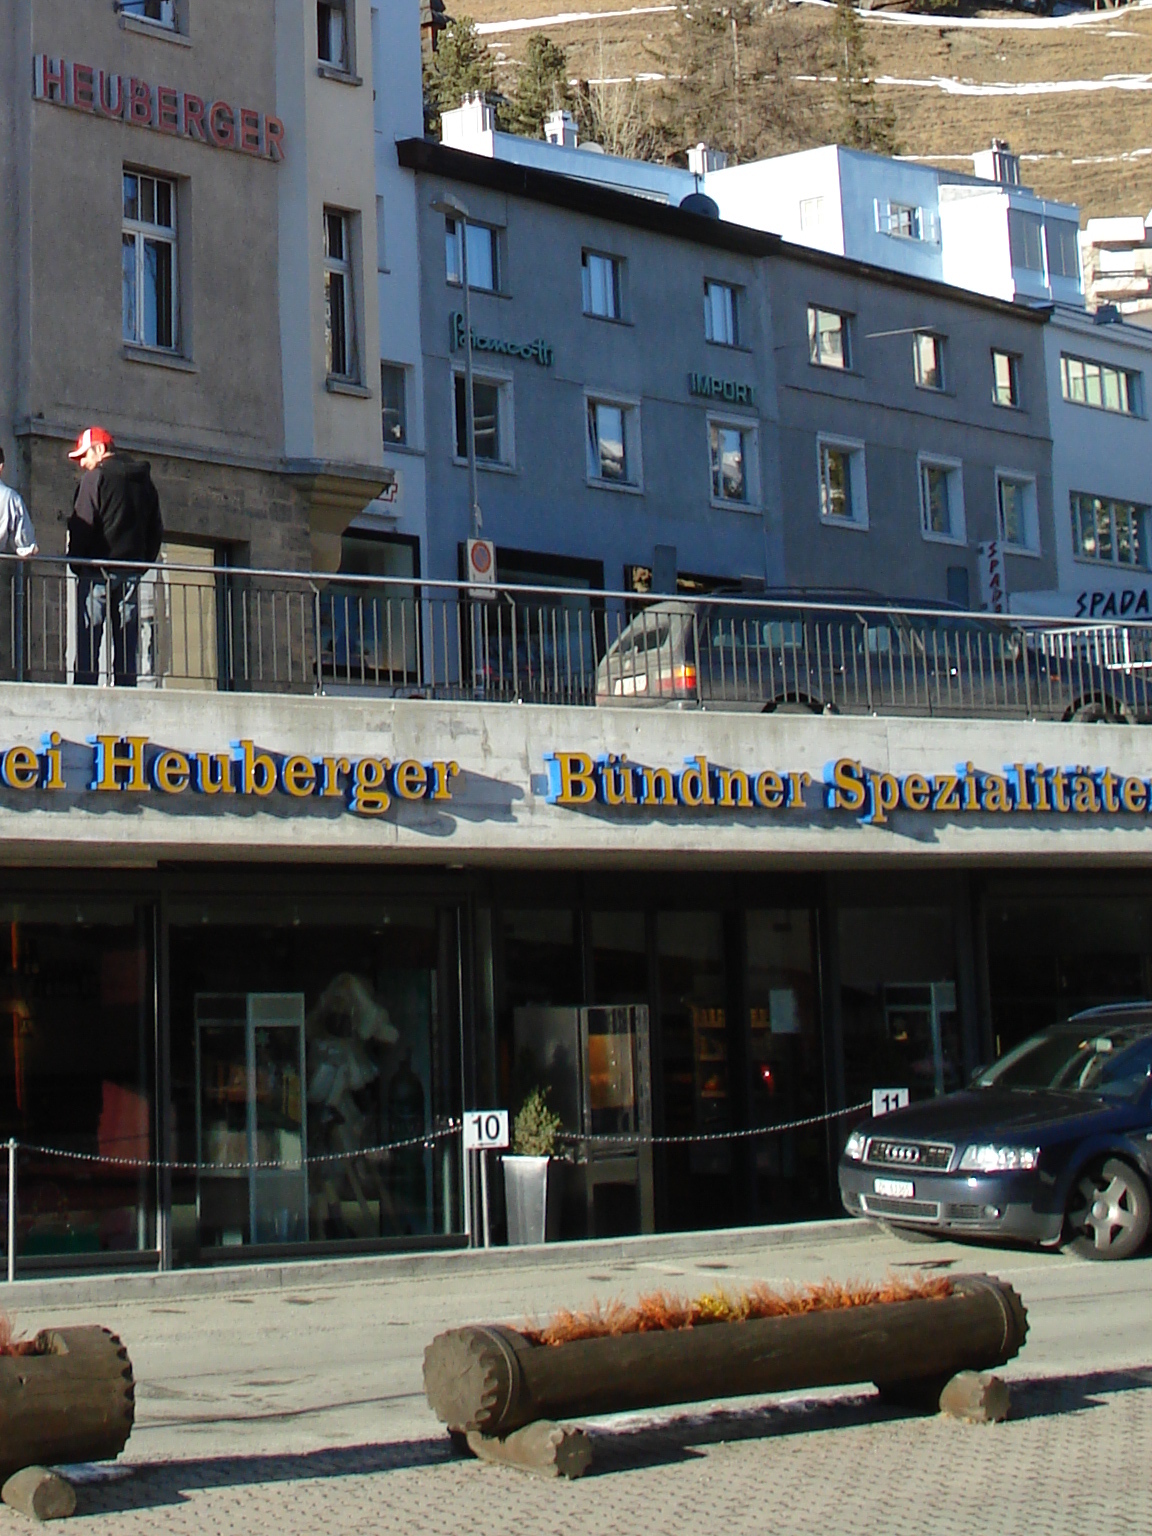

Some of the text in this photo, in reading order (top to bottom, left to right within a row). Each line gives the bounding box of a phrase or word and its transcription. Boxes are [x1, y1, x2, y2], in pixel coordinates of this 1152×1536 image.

[33, 54, 286, 162] HEUBERGER
[688, 371, 757, 405] IMPORT
[1074, 588, 1149, 618] SPADA
[86, 735, 460, 814] Heuberger
[544, 751, 1152, 824] Bündner Spezialitäte
[881, 1093, 899, 1112] 11
[472, 1114, 500, 1141] 10
